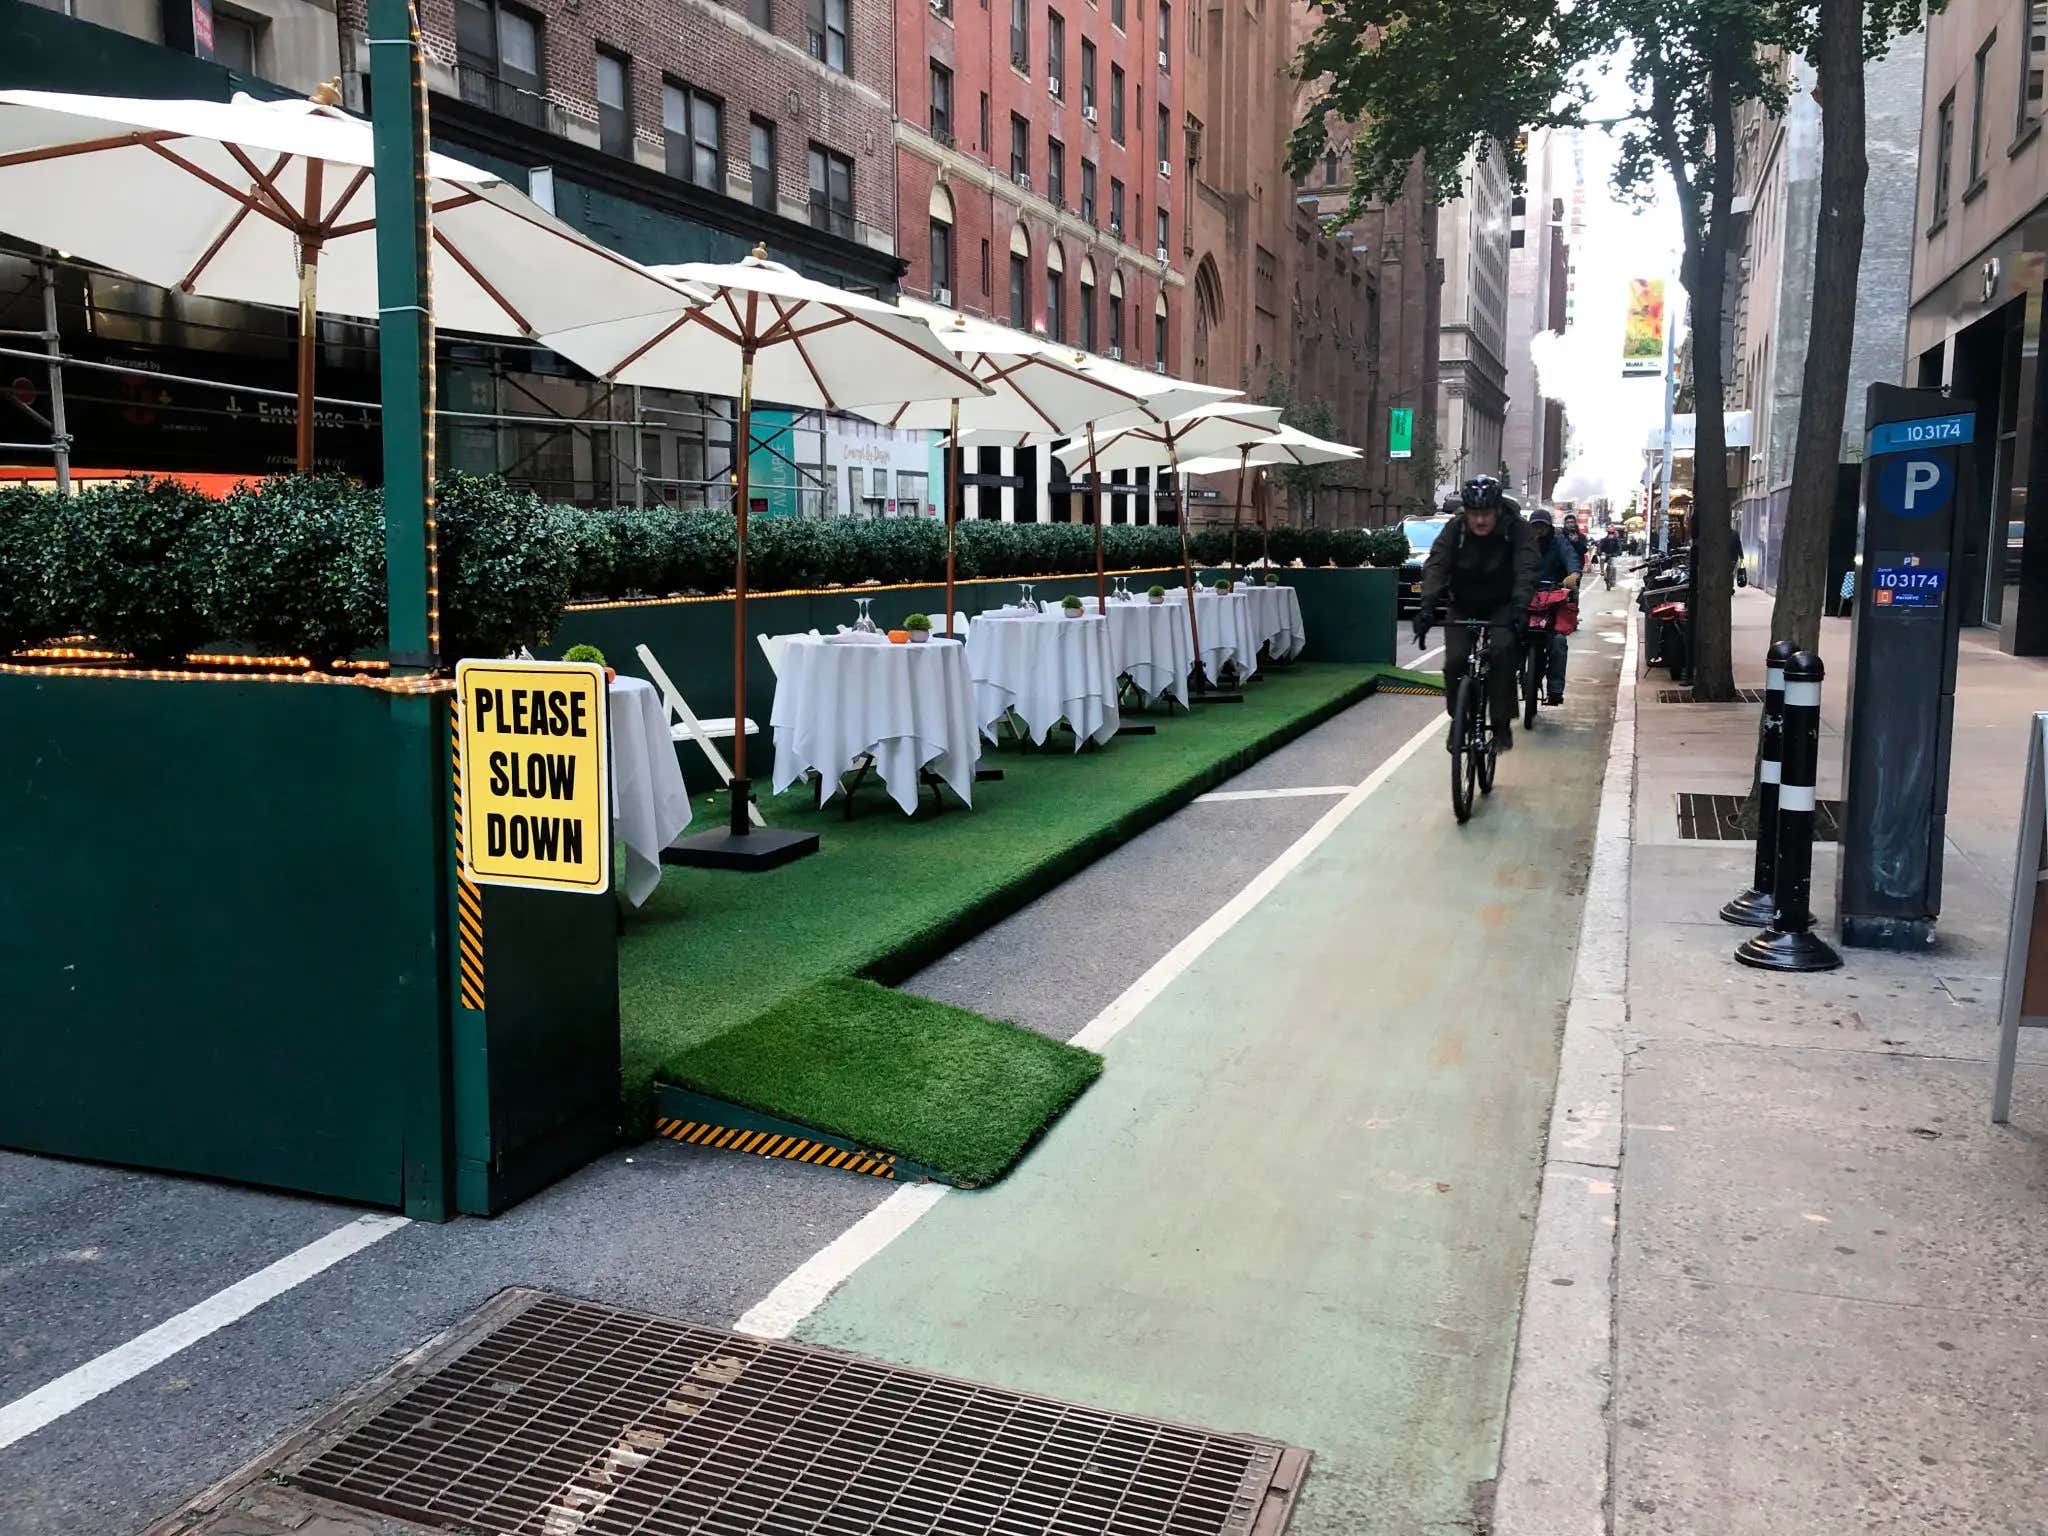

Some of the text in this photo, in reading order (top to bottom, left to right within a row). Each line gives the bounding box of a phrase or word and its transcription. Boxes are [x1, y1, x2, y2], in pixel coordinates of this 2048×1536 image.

[258, 402, 345, 428] Entrnce
[1907, 424, 1961, 441] 103174
[1904, 461, 1940, 510] P
[1880, 574, 1938, 588] 103174
[474, 688, 587, 738] PLEASE
[489, 750, 576, 801] SLOW
[487, 812, 583, 864] DOWN
